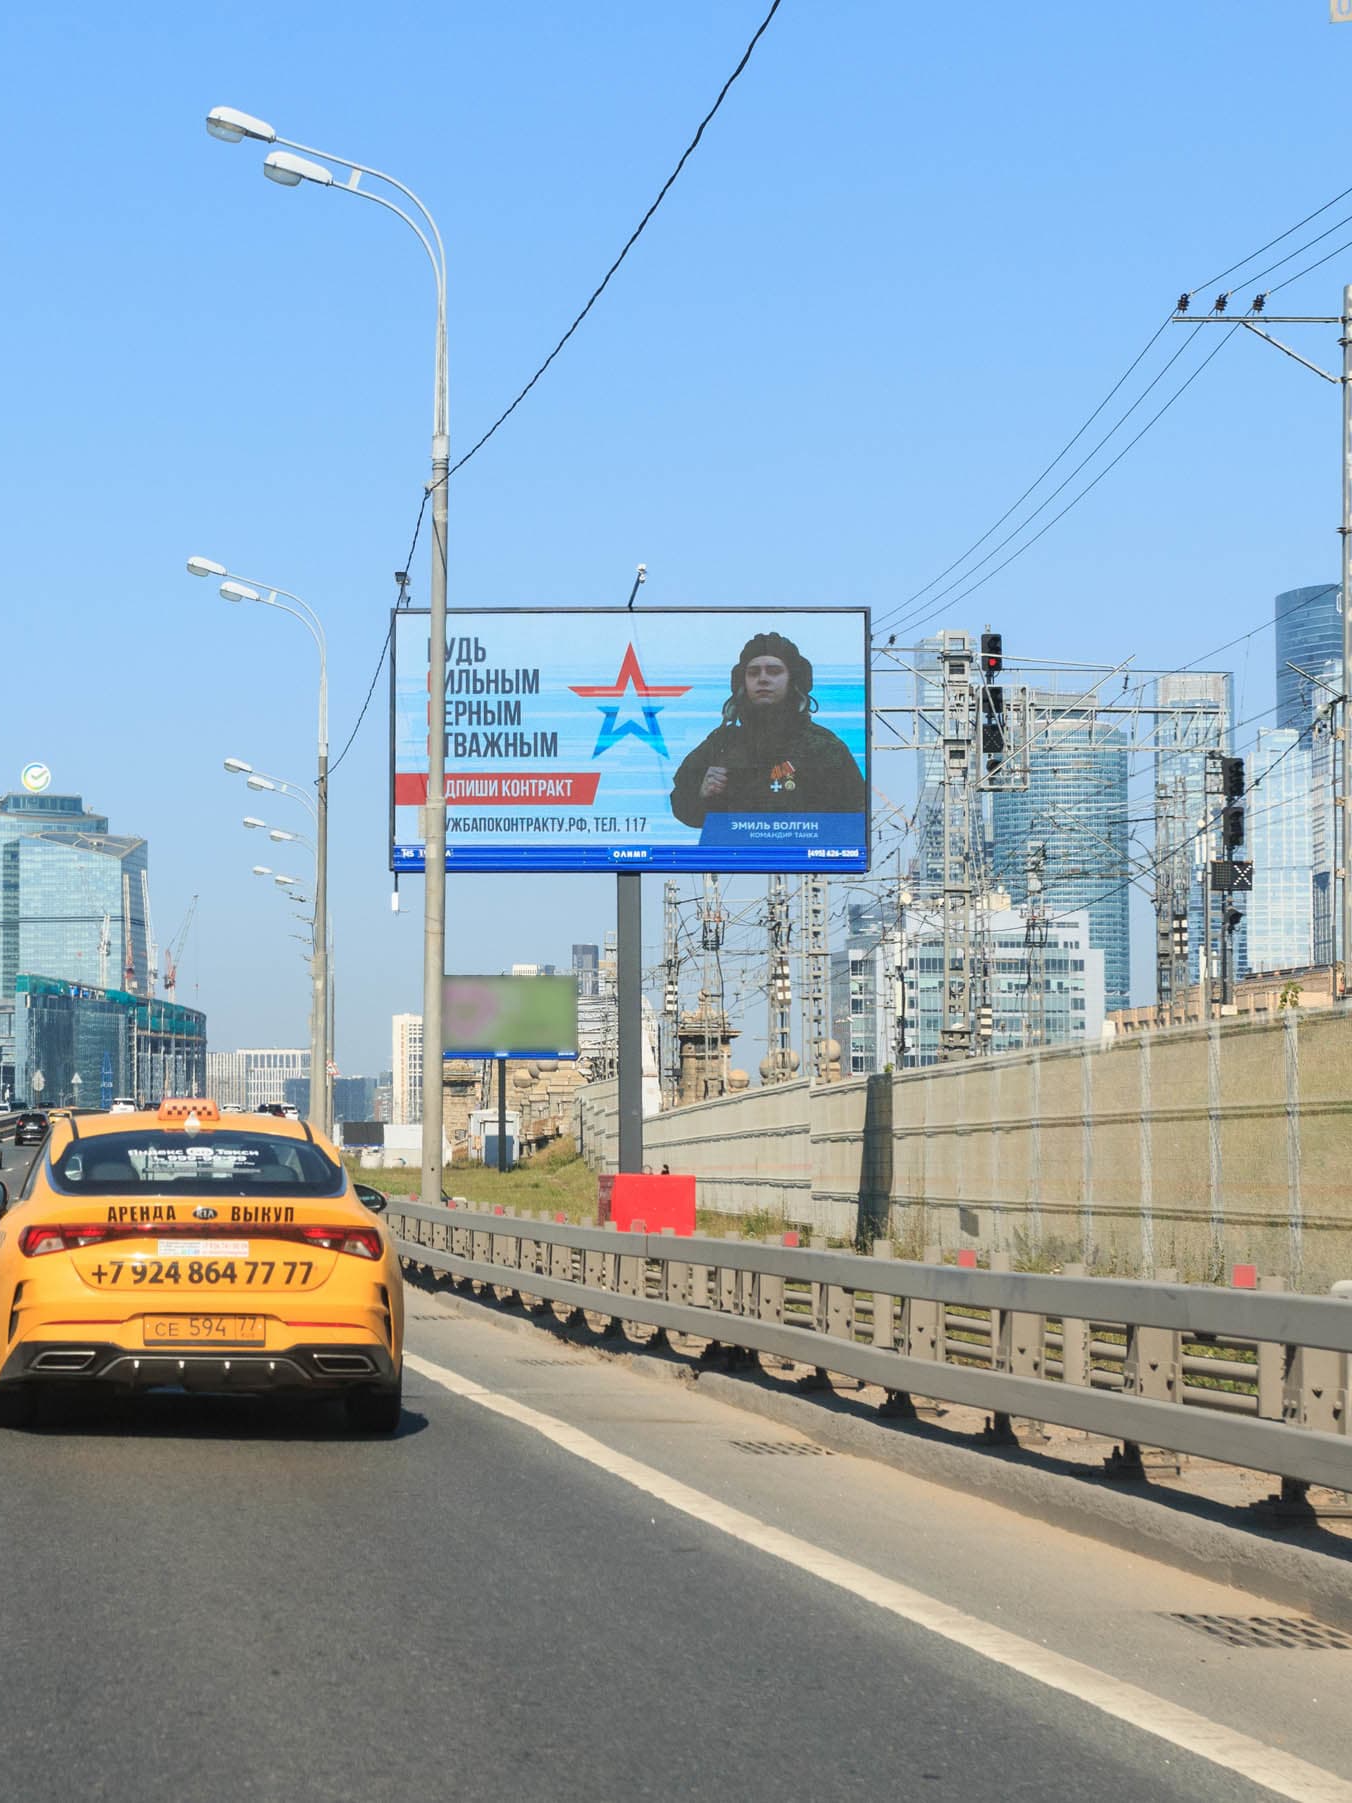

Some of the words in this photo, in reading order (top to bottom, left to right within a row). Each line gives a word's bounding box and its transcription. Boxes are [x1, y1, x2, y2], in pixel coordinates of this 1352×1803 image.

[427, 637, 487, 666] УДЬ
[427, 669, 540, 694] ИЛЬНЫМ
[427, 700, 521, 726] ЕРНЫМ
[427, 732, 558, 758] ТВАЖНЫМ
[427, 779, 499, 799] ДПИШИ
[502, 779, 573, 798] КОНТРАКТ
[595, 817, 621, 833] ТЕЛ.
[625, 817, 647, 833] 117
[731, 822, 770, 831] ЭМИЛЬ
[774, 822, 819, 831] ВОЛГИН
[613, 851, 647, 859] ОЛИМП
[215, 1147, 259, 1156] Такси
[107, 1205, 176, 1222] АРЕНДА
[231, 1206, 295, 1222] ВЫКУП
[92, 1260, 124, 1285] +7
[132, 1261, 181, 1285] 924
[188, 1261, 238, 1285] 864
[244, 1262, 276, 1285] 77
[283, 1262, 314, 1285] 77
[189, 1317, 226, 1337] 594
[238, 1316, 257, 1331] 77
